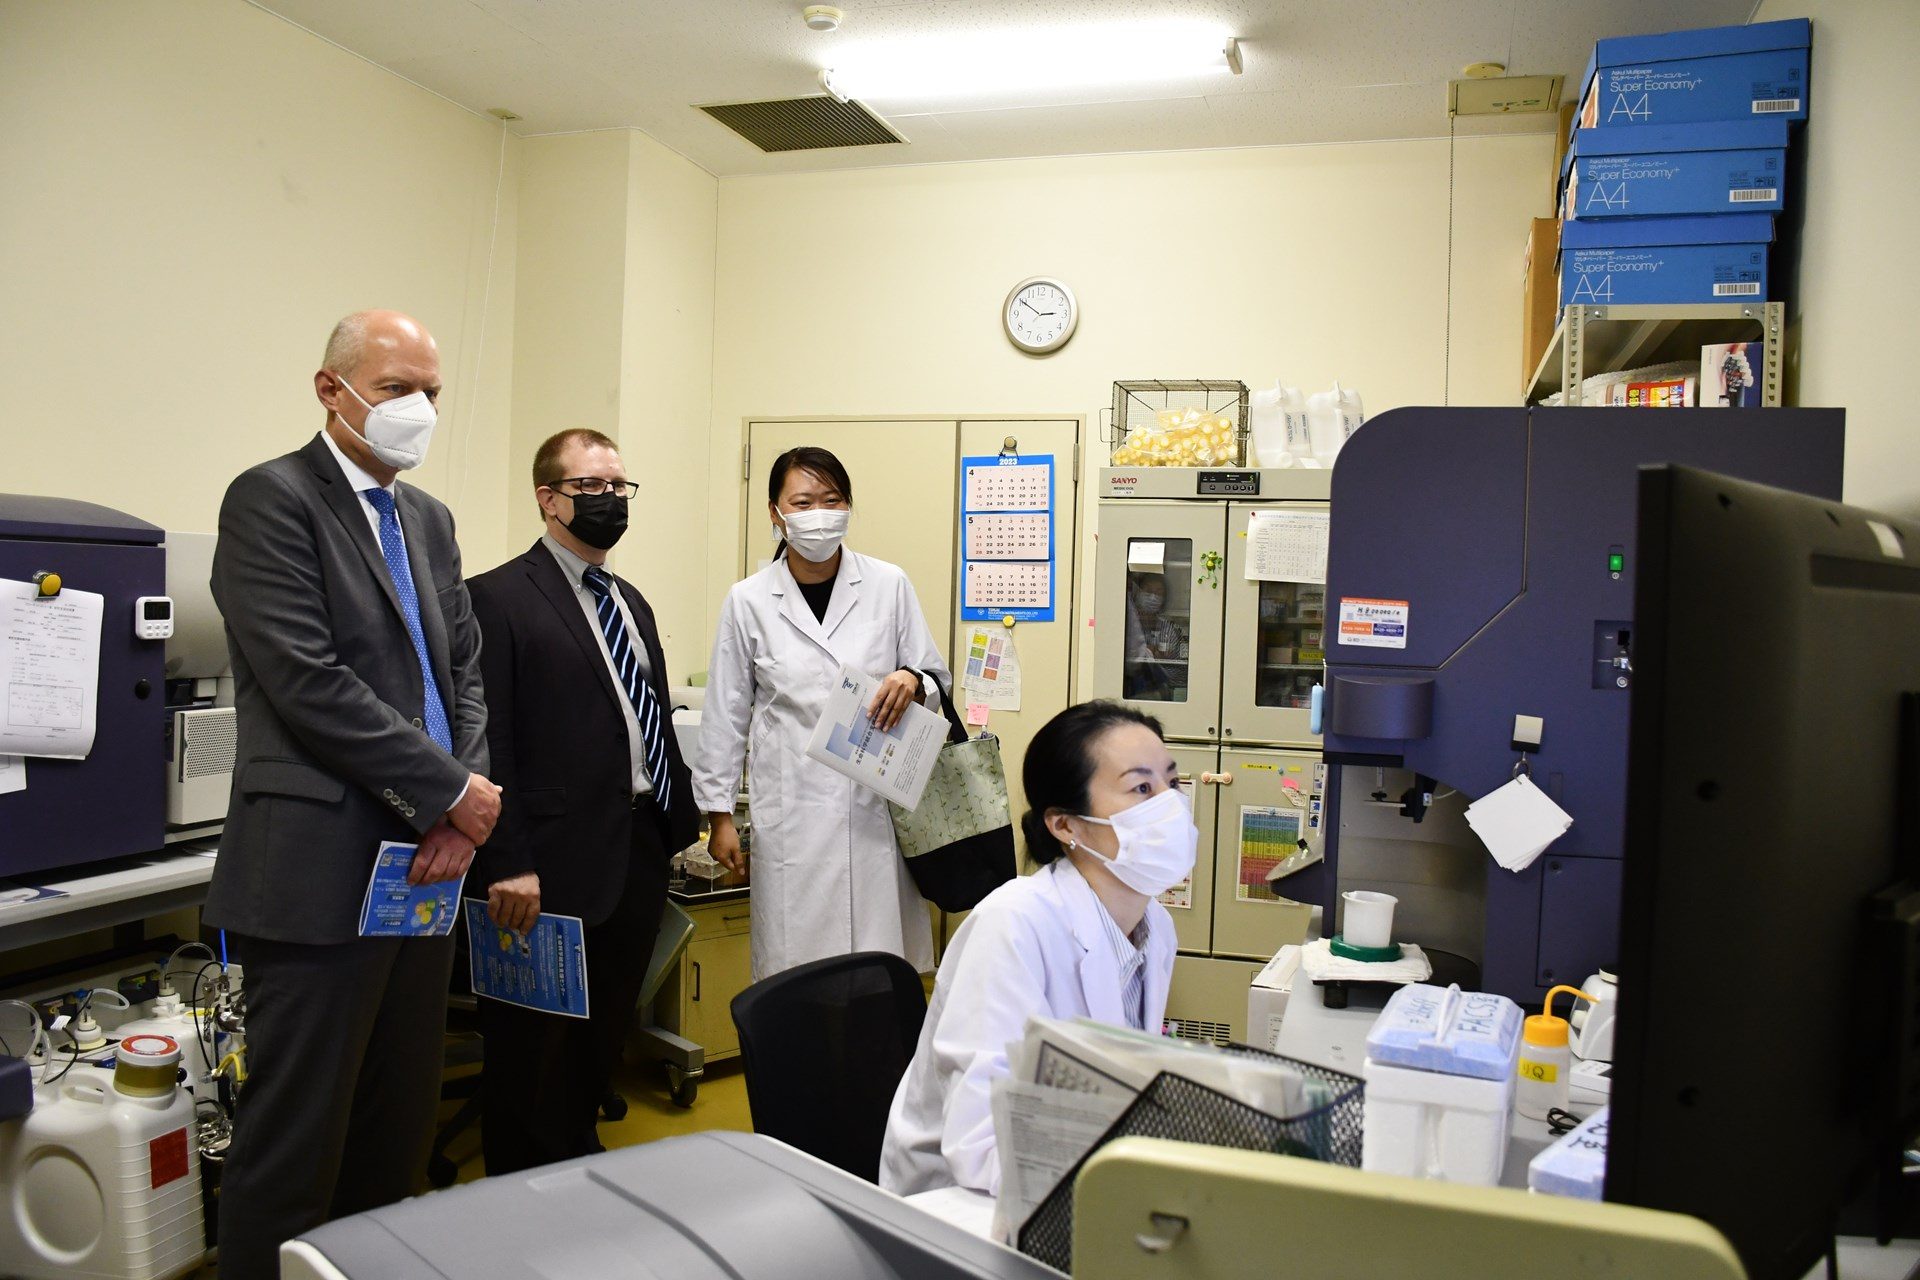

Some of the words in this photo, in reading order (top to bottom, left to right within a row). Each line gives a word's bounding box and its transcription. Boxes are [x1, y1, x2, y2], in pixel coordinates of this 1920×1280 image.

[1610, 81, 1643, 93] Super
[1608, 93, 1652, 122] A4
[1588, 170, 1620, 181] Super
[1586, 182, 1630, 211] A4
[1574, 262, 1606, 274] Super
[1037, 287, 1046, 296] 12
[1571, 274, 1614, 303] A4
[1027, 289, 1035, 298] 11
[1059, 297, 1064, 306] 2
[1061, 310, 1067, 318] 3
[1018, 323, 1023, 331] 8
[1027, 331, 1032, 339] 7
[1036, 333, 1042, 342] 6
[1048, 331, 1053, 339] 5
